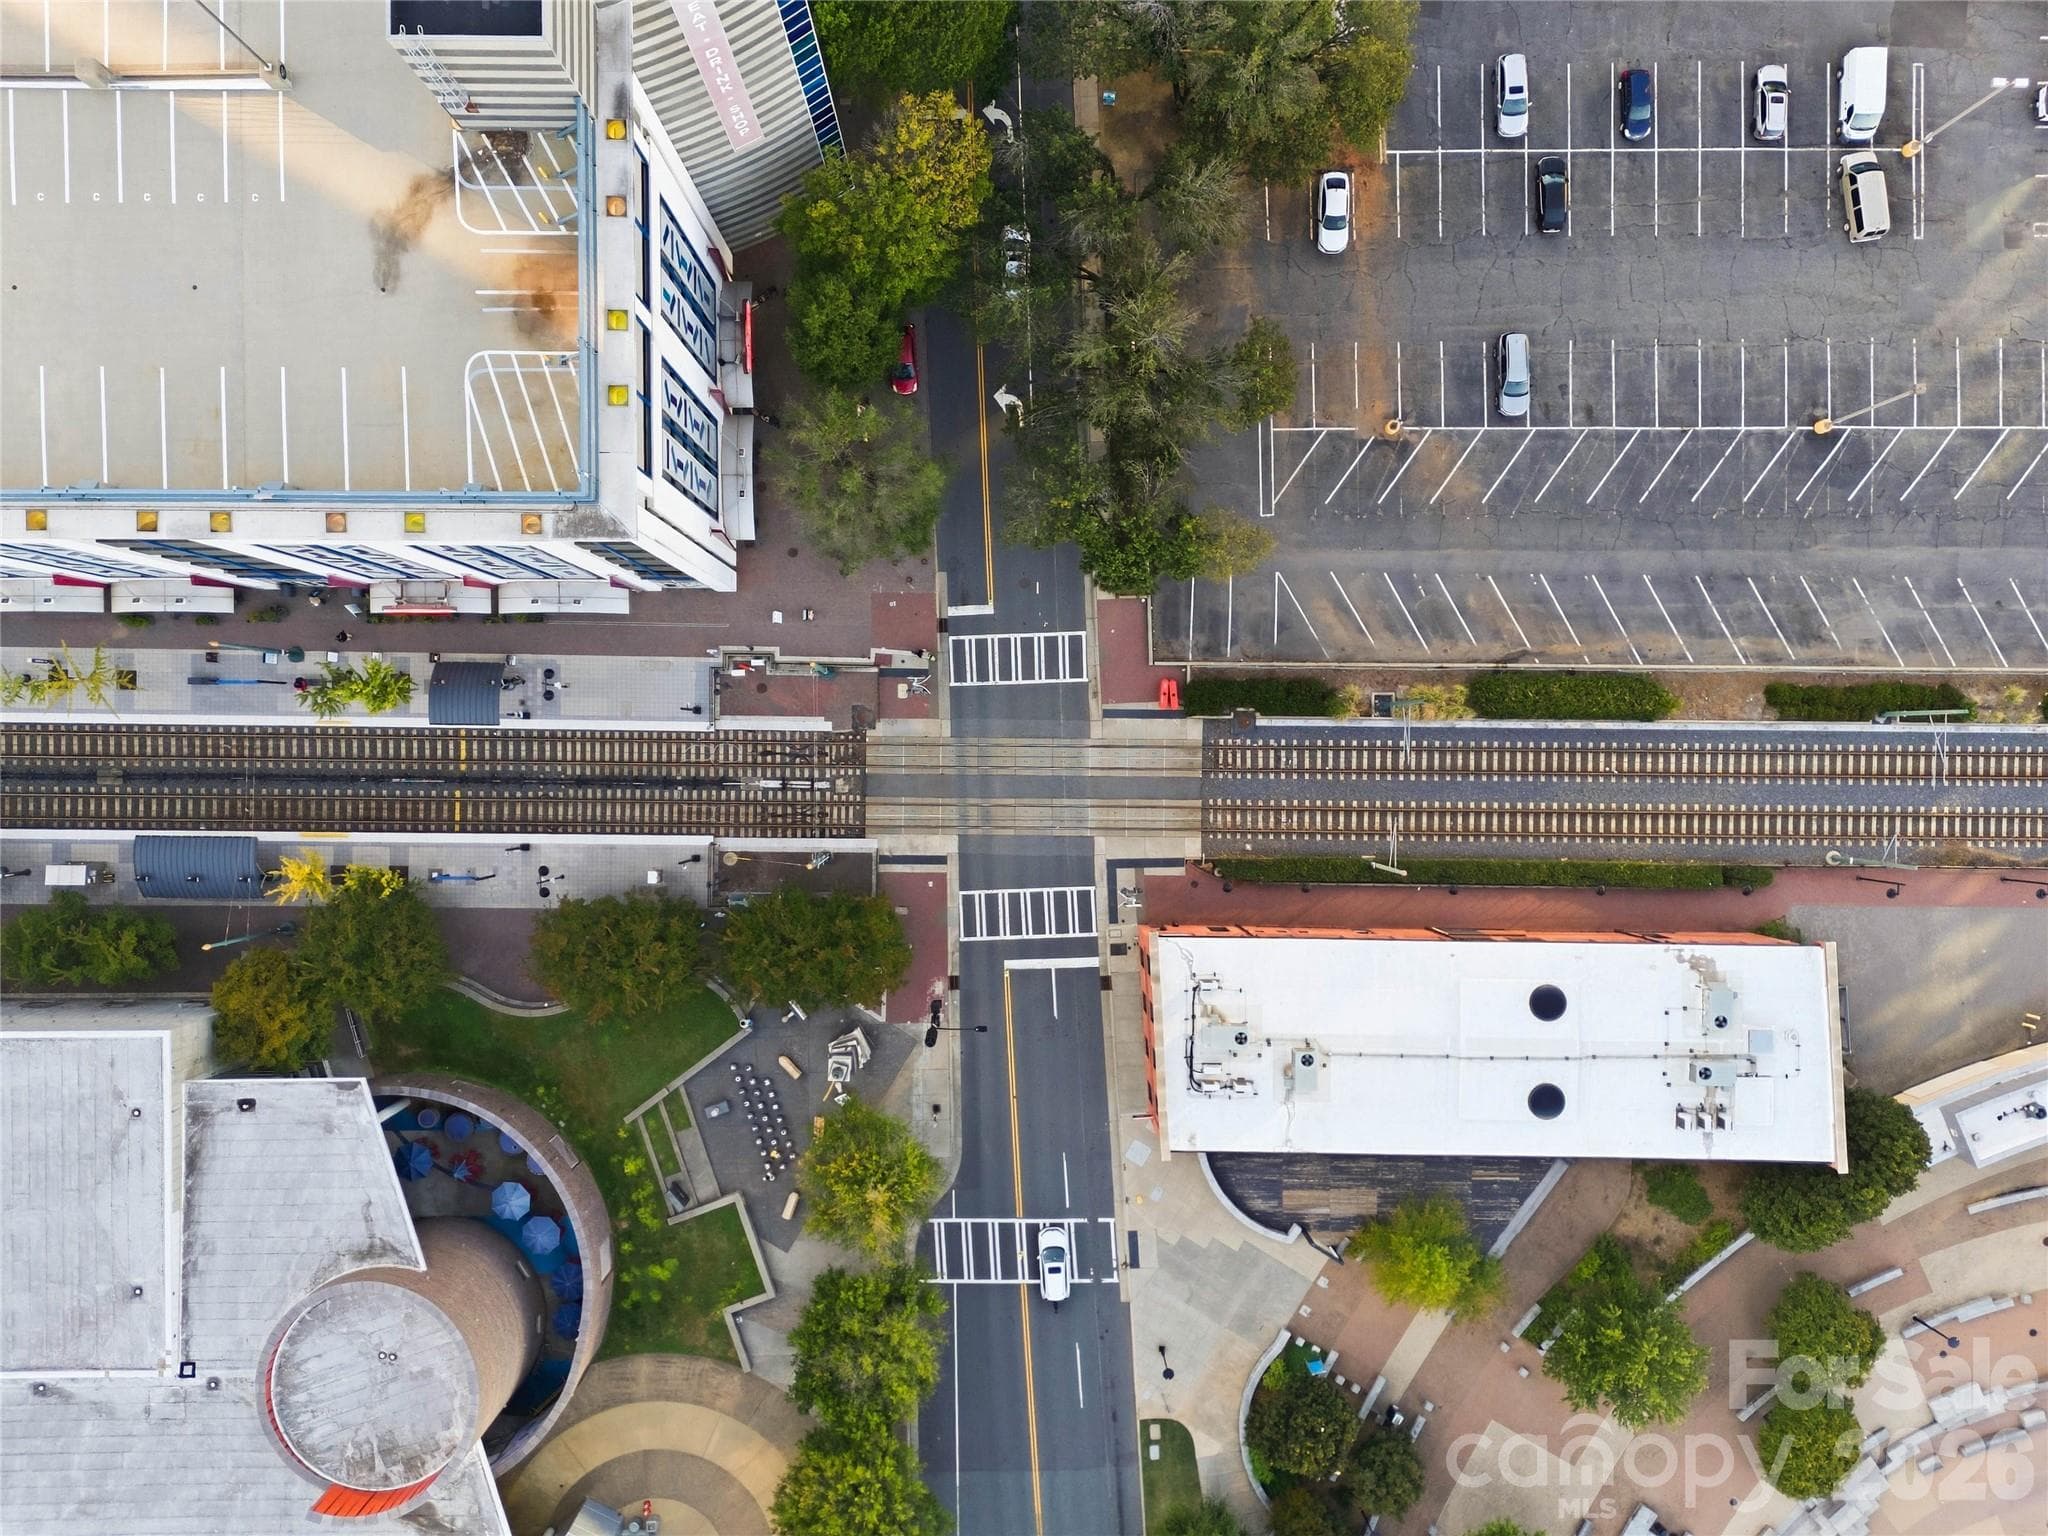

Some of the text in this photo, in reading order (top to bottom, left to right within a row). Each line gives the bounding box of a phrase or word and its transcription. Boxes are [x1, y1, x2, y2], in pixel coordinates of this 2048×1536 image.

[687, 1, 750, 137] EAT DRINK SHOP
